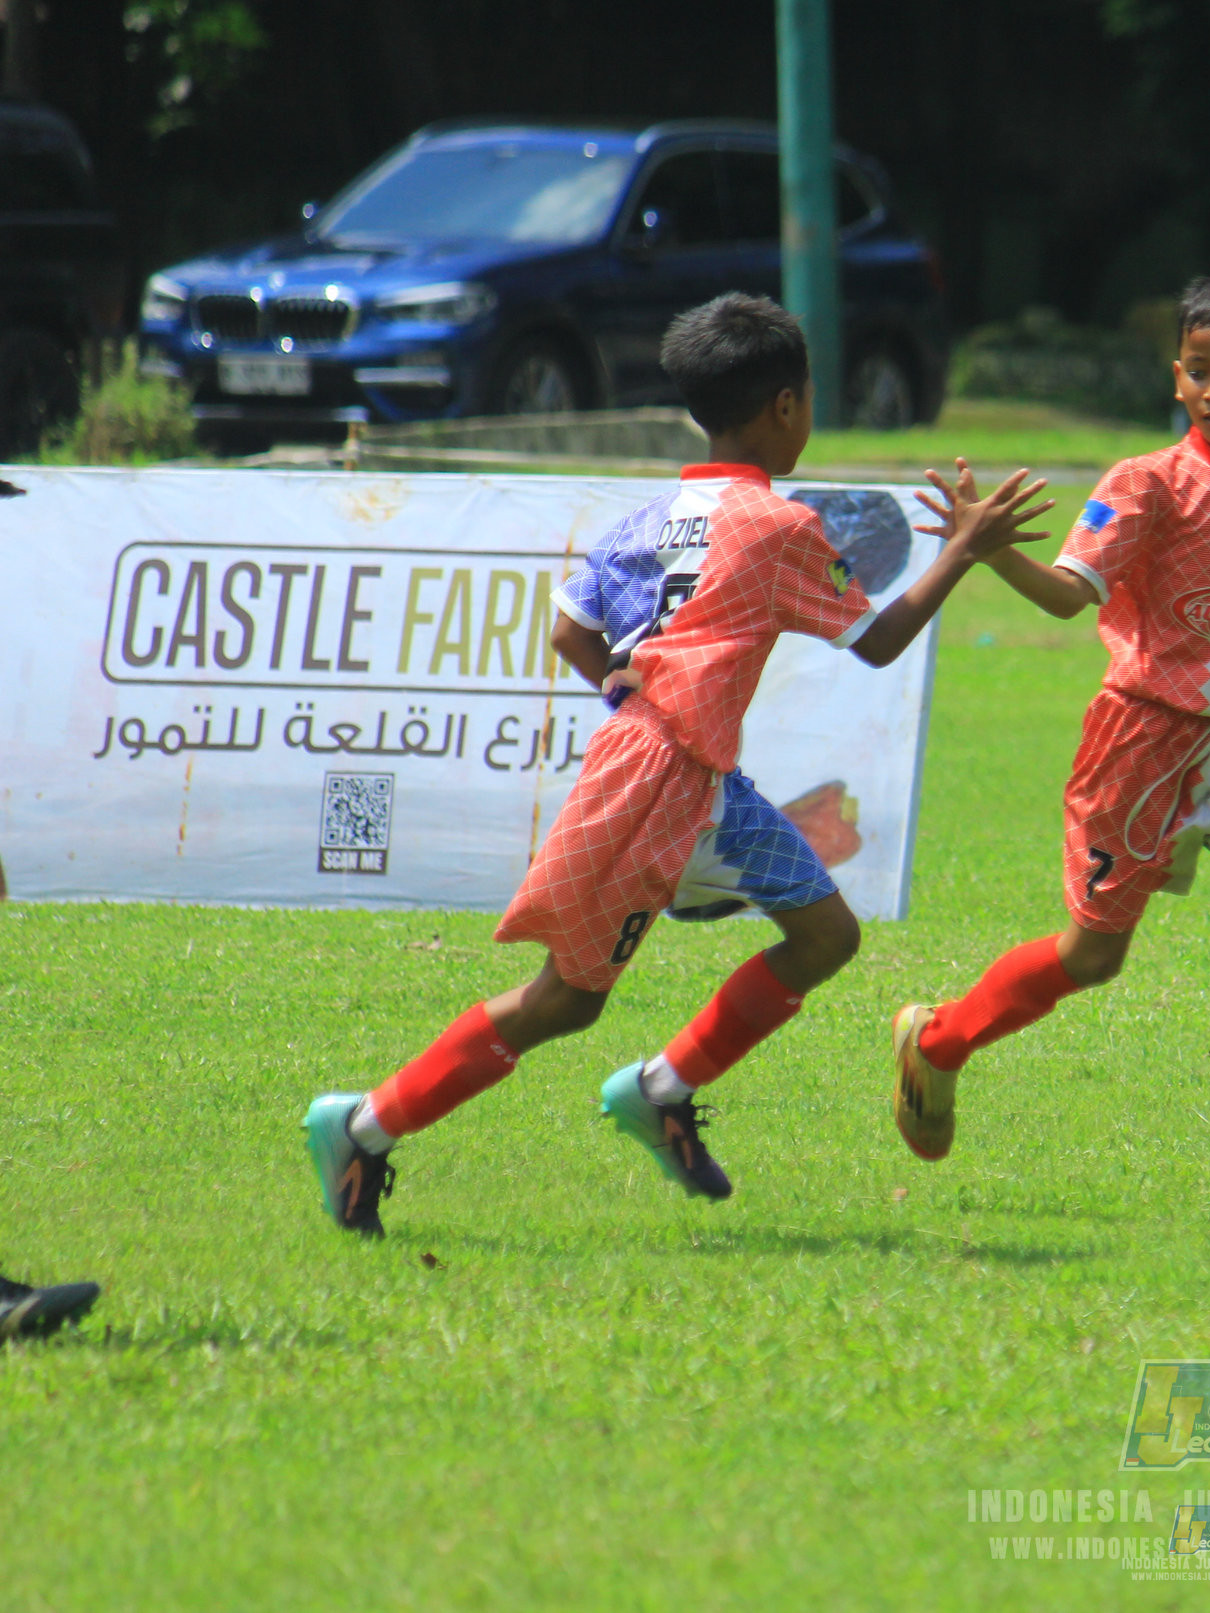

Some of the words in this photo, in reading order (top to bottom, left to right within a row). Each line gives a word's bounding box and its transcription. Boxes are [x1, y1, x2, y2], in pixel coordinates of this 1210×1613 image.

[655, 516, 710, 550] OZIEL
[122, 558, 382, 673] CASTLE
[93, 704, 265, 760] للتمور
[283, 701, 468, 759] القلعة
[484, 714, 585, 772] زارع
[322, 850, 358, 871] SCAN
[360, 851, 383, 872] ME
[1086, 847, 1114, 900] 7
[610, 911, 651, 966] 8
